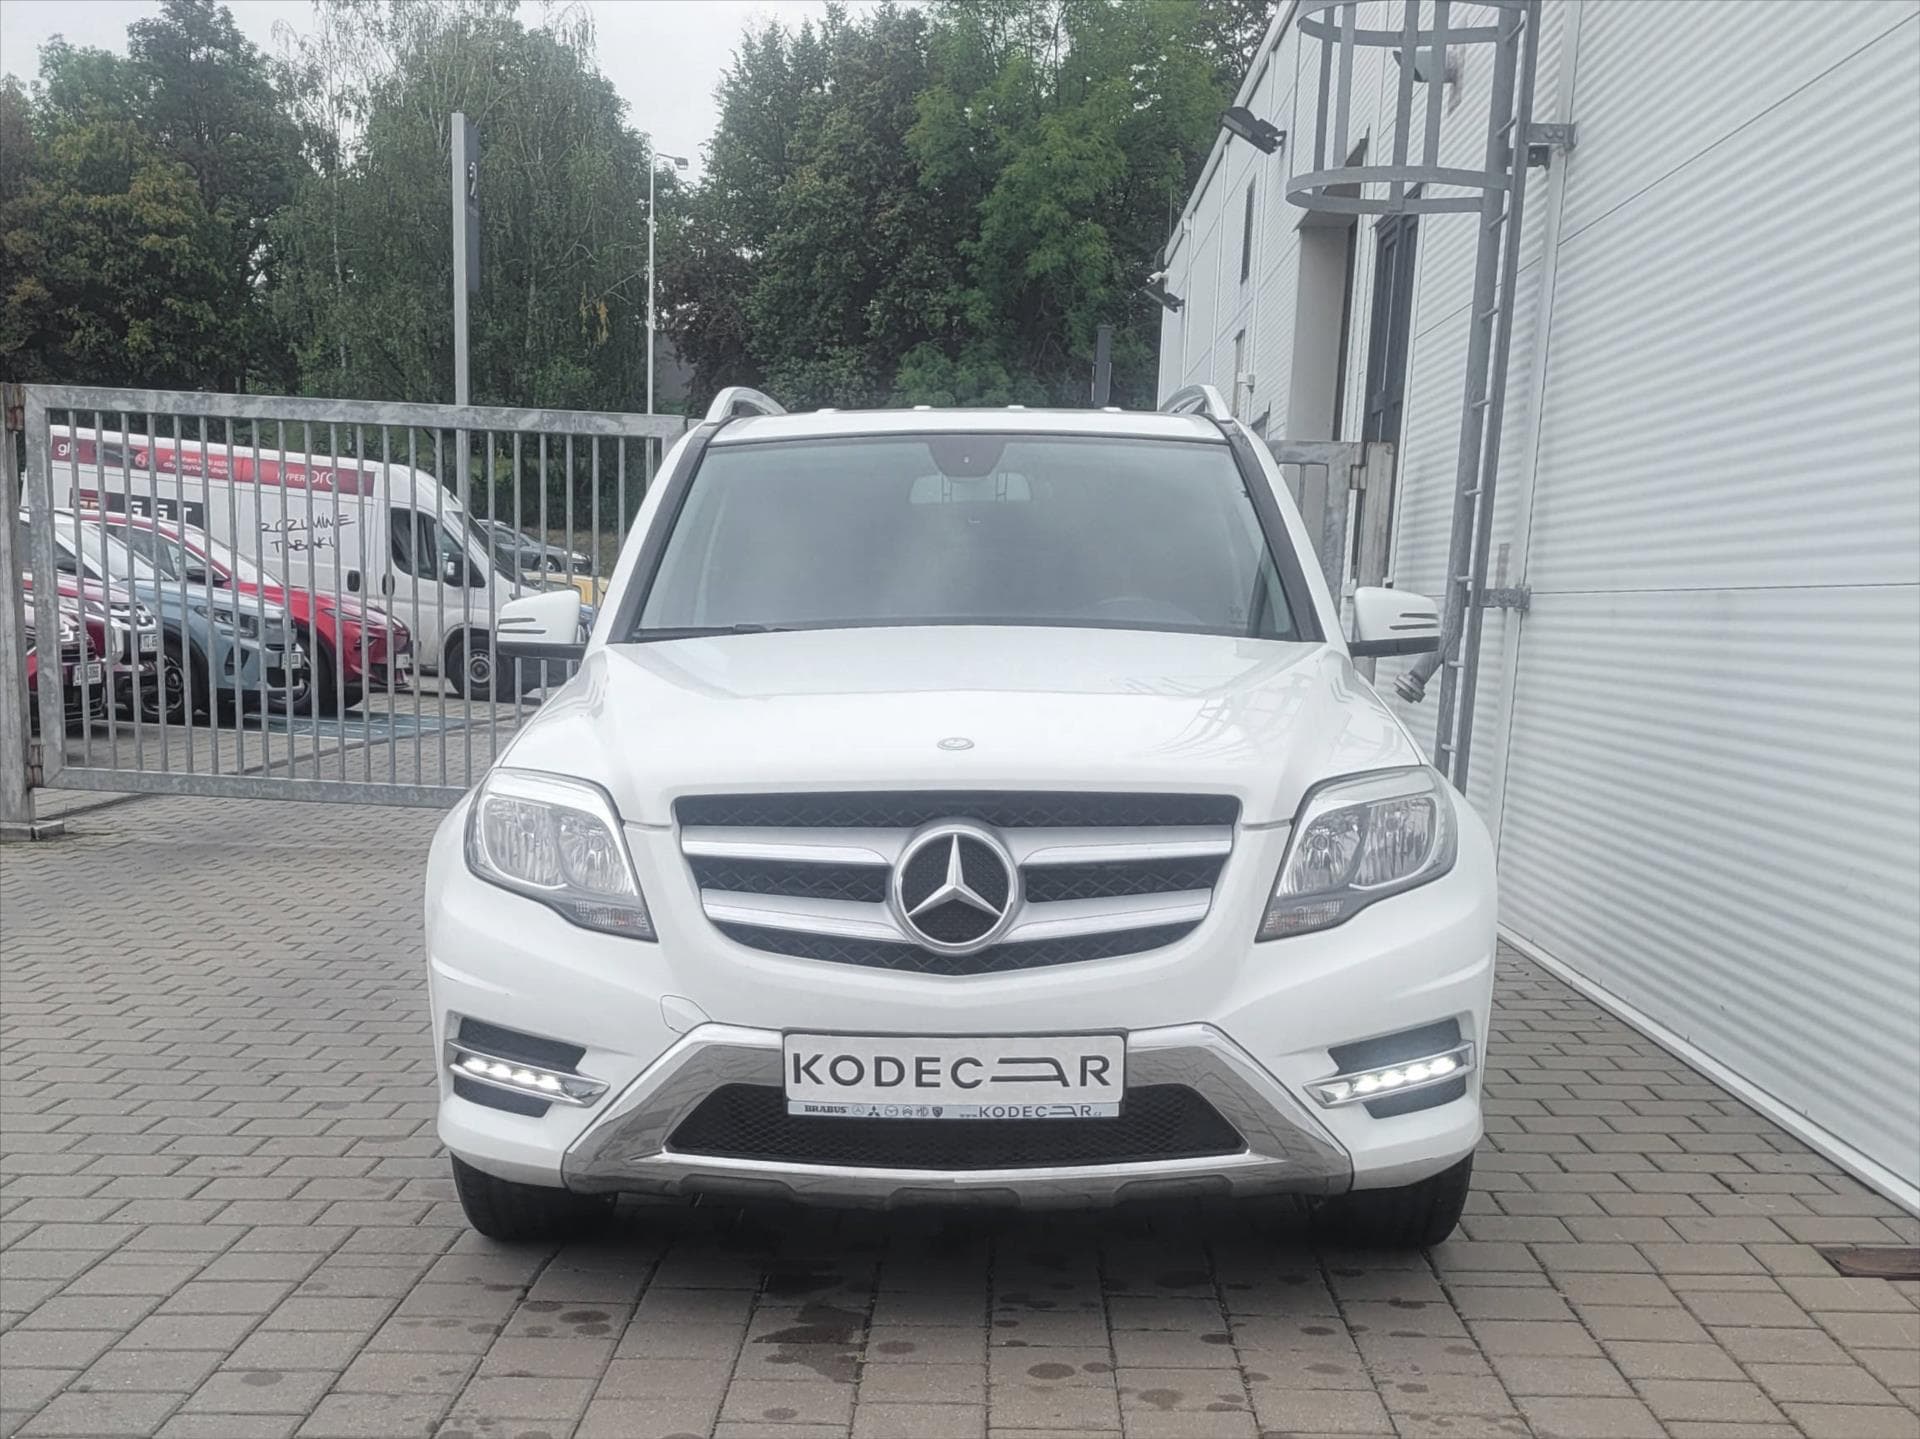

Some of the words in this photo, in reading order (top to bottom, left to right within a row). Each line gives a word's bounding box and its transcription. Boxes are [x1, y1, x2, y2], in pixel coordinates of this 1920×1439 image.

[57, 442, 79, 456] gl
[792, 1052, 1112, 1089] KODECAR
[804, 1104, 848, 1114] BRABUS
